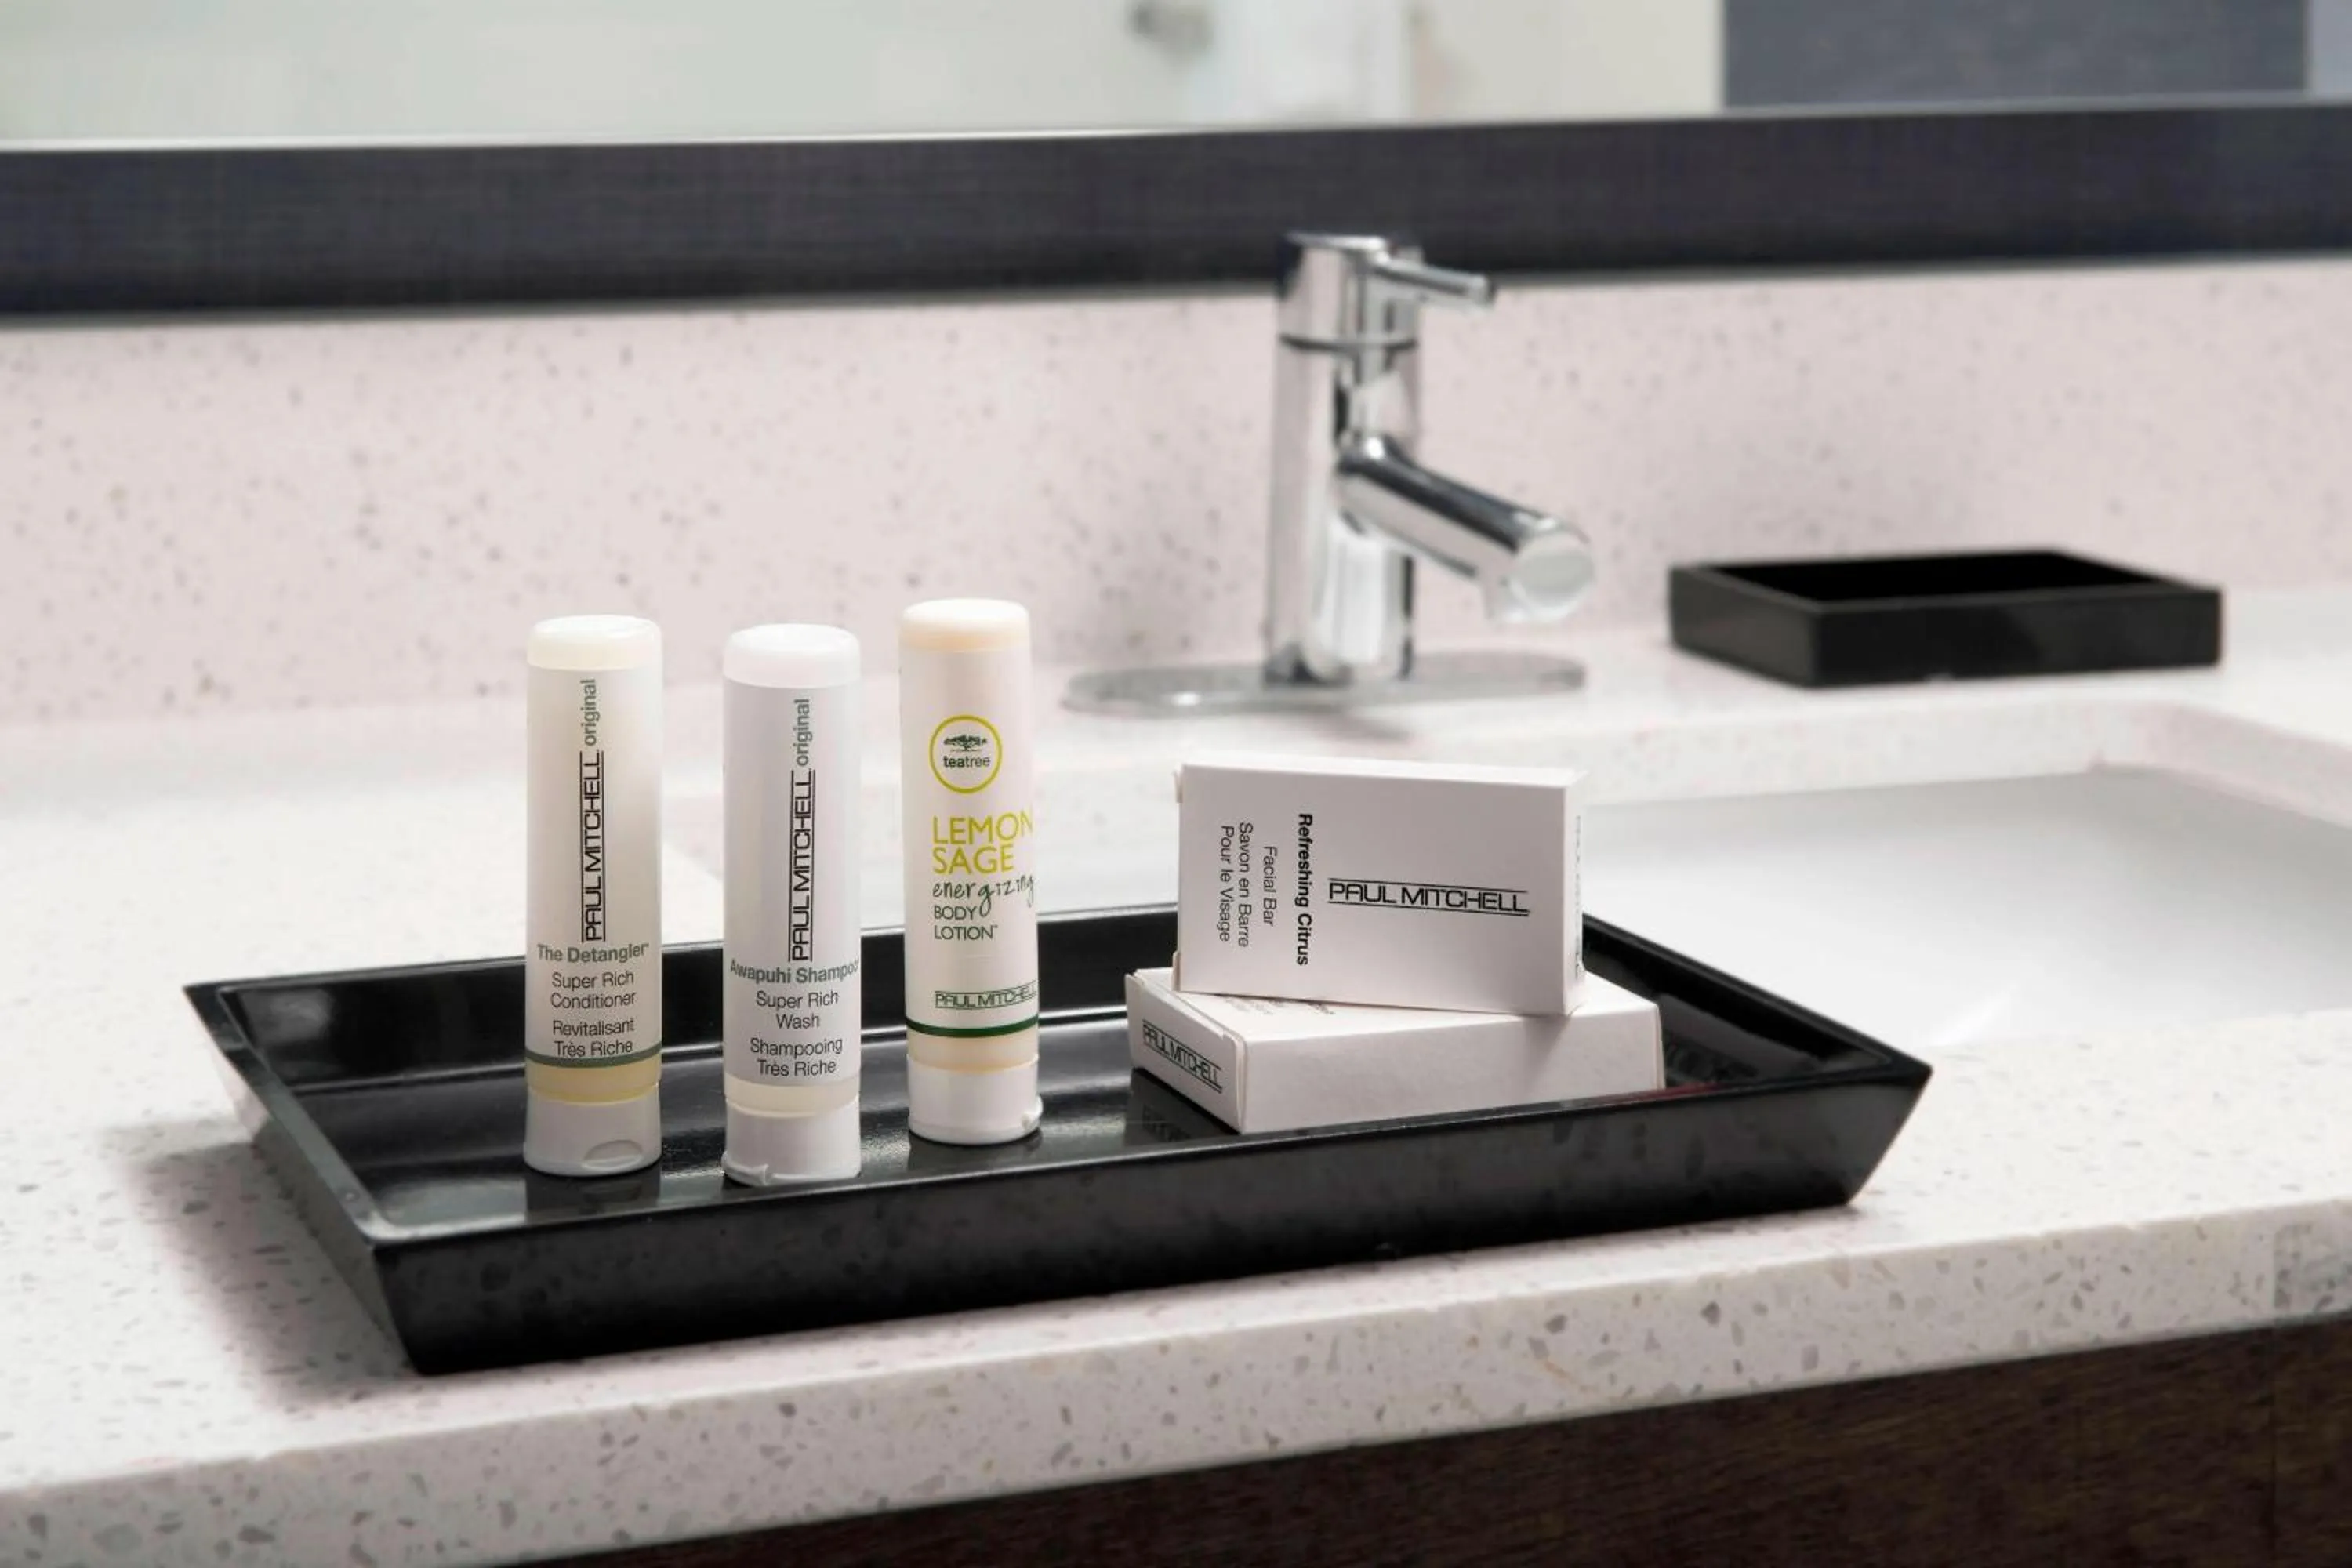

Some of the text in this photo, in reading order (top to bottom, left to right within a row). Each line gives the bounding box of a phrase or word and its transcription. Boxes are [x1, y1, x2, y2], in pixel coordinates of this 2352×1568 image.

[943, 755, 991, 768] teatree
[580, 679, 603, 941] PAUL MITCHELL original
[792, 699, 813, 961] PAUL MITCHELL original
[932, 804, 1033, 845] LEMON
[932, 844, 1014, 875] SAGE
[932, 873, 1034, 917] energizing
[1217, 826, 1235, 942] Pour le Visage
[1238, 822, 1254, 948] Savon en Barre
[1263, 846, 1278, 927] Facial Bar
[1295, 814, 1313, 966] Refreshing Citrus
[1330, 882, 1530, 913] PAUL MITCHELL
[934, 905, 977, 921] BODY
[536, 944, 563, 961] The
[552, 971, 634, 992] Super Rich
[730, 958, 791, 984] Awapuhi
[550, 992, 636, 1009] Conditioner
[756, 989, 839, 1011] Super Rich
[935, 993, 976, 1008] PAUL
[553, 1018, 636, 1036] Revitalisant
[775, 1012, 820, 1029] Wash
[554, 1040, 633, 1057] Très Riche
[750, 1037, 843, 1059] Shampooing
[1142, 1023, 1222, 1090] PAUL MITCHELL
[757, 1058, 837, 1076] Très Riche
